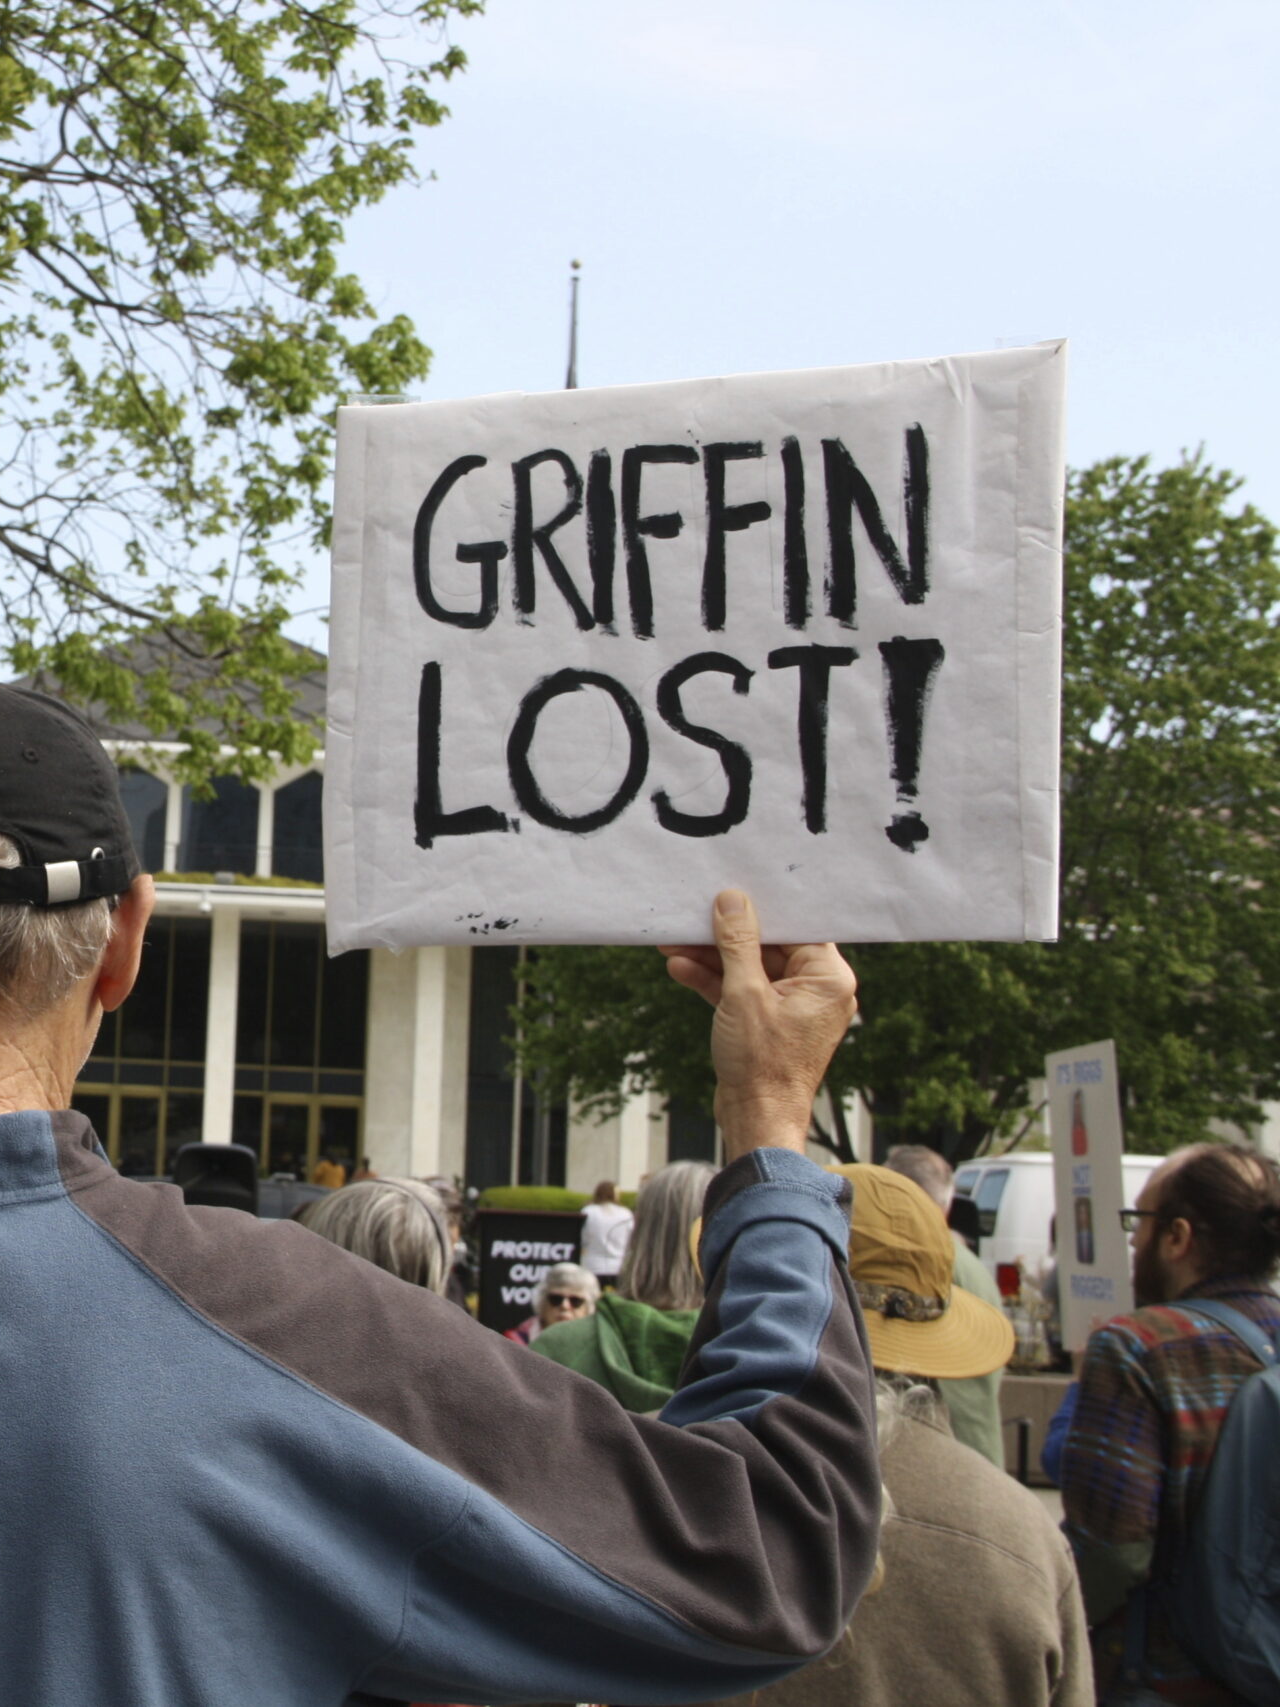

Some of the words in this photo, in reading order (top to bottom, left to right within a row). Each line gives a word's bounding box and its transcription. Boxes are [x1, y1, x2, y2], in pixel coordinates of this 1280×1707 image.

[412, 421, 932, 639] GRIFFIN
[412, 634, 946, 854] LOST!
[490, 1240, 575, 1261] PROTECT
